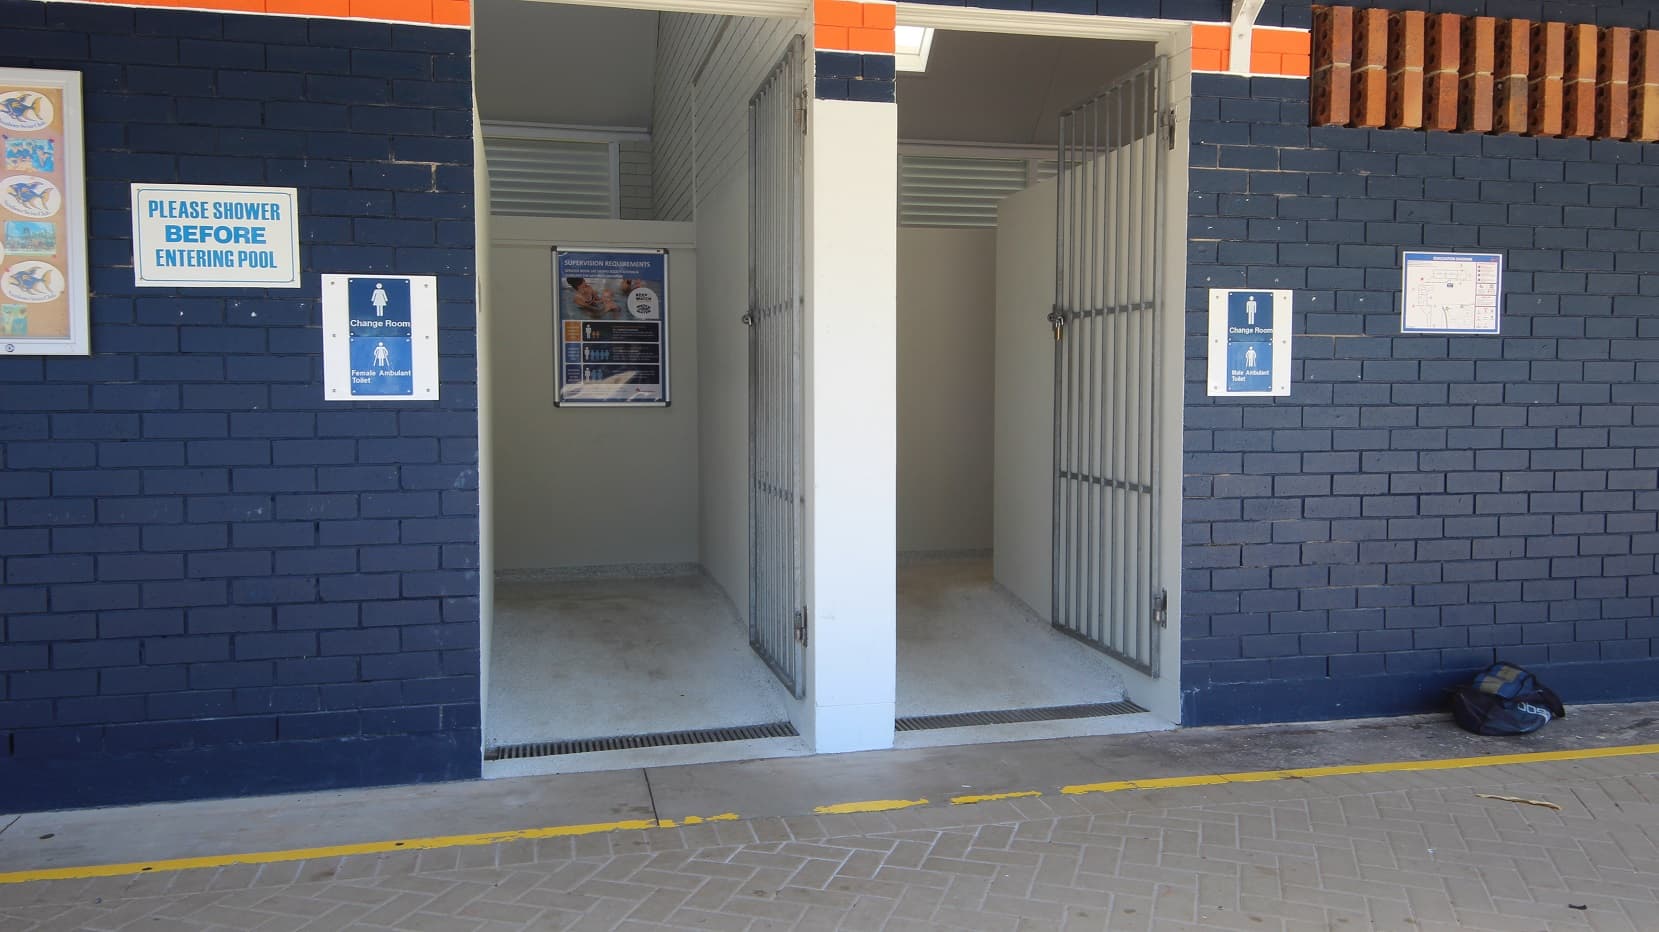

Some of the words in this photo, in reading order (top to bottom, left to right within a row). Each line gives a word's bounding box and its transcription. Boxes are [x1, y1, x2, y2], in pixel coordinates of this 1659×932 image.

[148, 199, 209, 219] PLEASE
[213, 201, 281, 221] SHOWER
[165, 224, 267, 245] BEFORE
[156, 248, 235, 268] ENTERING
[238, 250, 278, 269] POOL
[563, 259, 604, 267] SUPERVISION
[605, 260, 651, 268] REQUIREMENTS
[350, 319, 383, 329] Change
[385, 319, 411, 328] Room
[1229, 326, 1254, 335] Change
[1254, 326, 1274, 334] Room
[351, 369, 376, 377] Female
[379, 369, 412, 377] Ambulant
[351, 376, 371, 384] Toilet
